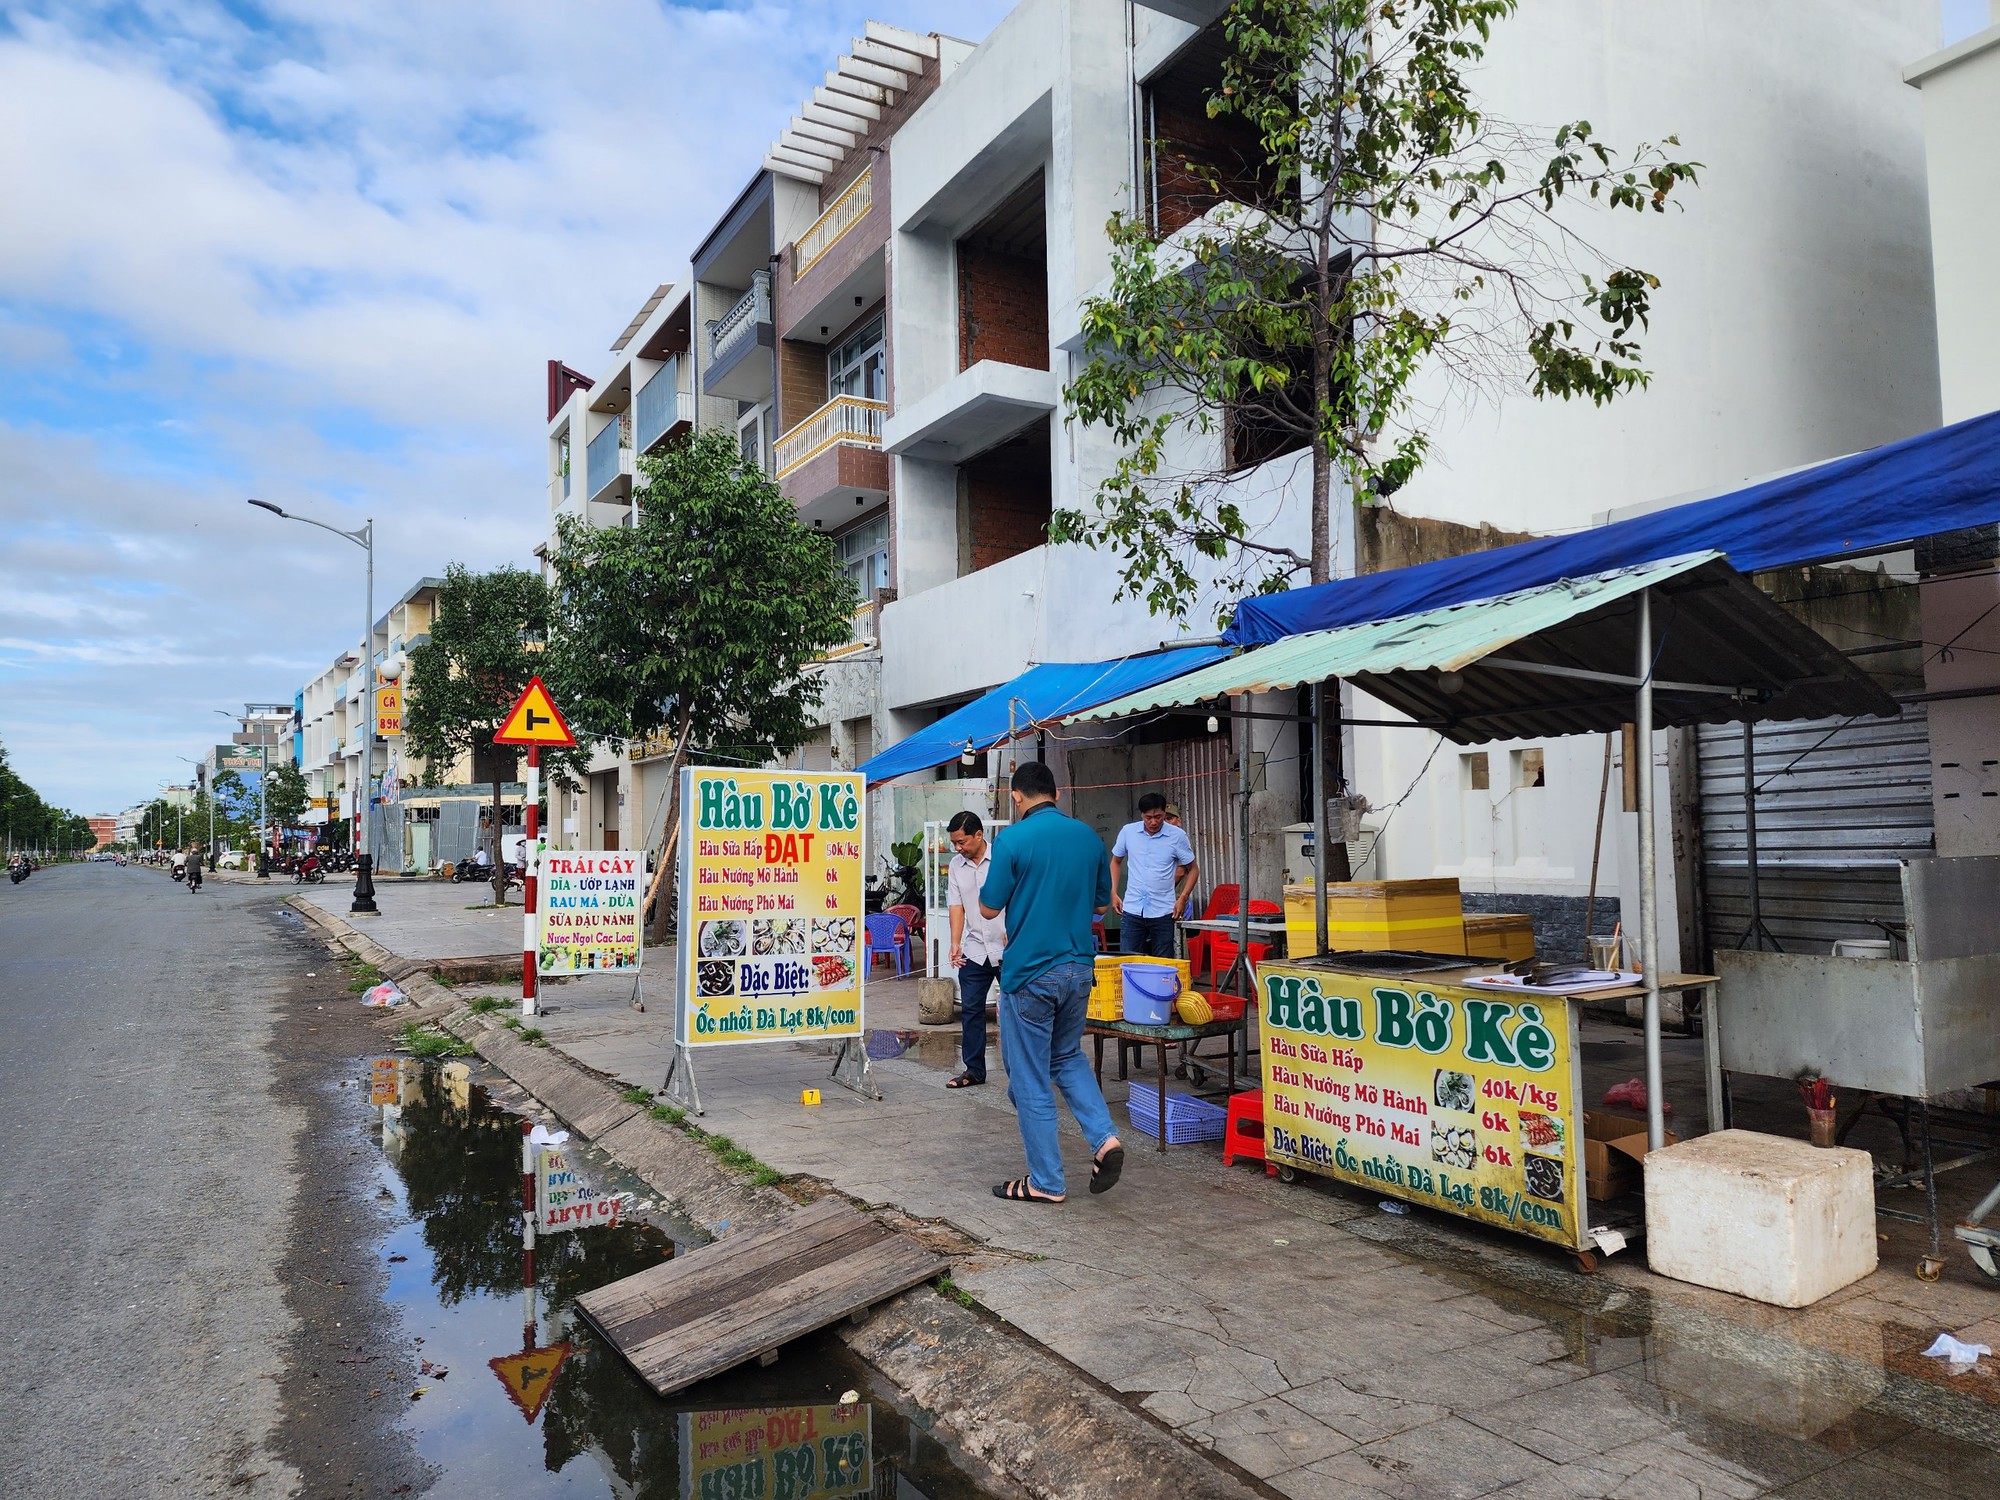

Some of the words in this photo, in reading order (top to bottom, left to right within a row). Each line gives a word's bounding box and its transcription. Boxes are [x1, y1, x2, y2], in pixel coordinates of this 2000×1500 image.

[380, 718, 399, 730] 89K
[699, 780, 762, 829] Hàu
[771, 781, 811, 829] Bờ
[818, 781, 859, 830] Kè
[699, 840, 719, 856] Hàu
[722, 840, 740, 856] Sữa
[744, 838, 762, 859] Hấp
[765, 833, 814, 867] ĐẠT
[549, 856, 594, 874] TRÁI
[598, 856, 636, 874] CÂY
[826, 868, 838, 882] 6k
[550, 877, 570, 890] DĨA
[580, 877, 602, 890] ƯỚP
[604, 880, 634, 892] LẠNH
[699, 868, 718, 884] Hàu
[722, 868, 754, 887] Nướng
[774, 868, 798, 883] Hành
[550, 896, 578, 908] RAU
[580, 894, 598, 908] MÁ
[608, 894, 634, 908] DỪA
[698, 896, 718, 911] Hàu
[722, 895, 754, 914] Nướng
[756, 894, 774, 910] Phô
[826, 894, 838, 908] 6k
[549, 912, 572, 926] SỮA
[575, 912, 600, 928] ĐẬU
[602, 912, 634, 926] NÀNH
[740, 963, 770, 998] Đặc
[774, 961, 809, 996] Biệt:
[696, 1003, 716, 1034] Ốc
[720, 1006, 752, 1032] nhồi
[756, 1008, 776, 1029] Đà
[780, 1008, 803, 1034] Lạt
[806, 1006, 854, 1030] 8k/con
[1266, 976, 1360, 1038] Hàu
[1374, 990, 1452, 1052] Bờ
[1465, 1000, 1553, 1068] Kè
[1270, 1038, 1297, 1058] Hàu
[1300, 1043, 1328, 1064] Sữa
[1332, 1048, 1364, 1072] Hấp
[808, 1091, 814, 1101] 7
[1272, 1066, 1300, 1086] Hàu
[1302, 1072, 1350, 1102] Nướng
[1354, 1082, 1378, 1104] Mỡ
[1382, 1088, 1428, 1116] Hành
[1482, 1078, 1558, 1112] 40k/kg
[1273, 1094, 1300, 1116] Hàu
[1304, 1101, 1351, 1133] Nướng
[1356, 1114, 1386, 1137] Phô
[1390, 1122, 1420, 1146] Mai
[1482, 1111, 1511, 1132] 6k
[1484, 1144, 1514, 1167] 6k
[1272, 1126, 1298, 1159] Đặc
[1300, 1134, 1333, 1168] Biệt:
[1334, 1138, 1358, 1172] Ốc
[1362, 1155, 1404, 1186] nhồi
[1406, 1165, 1436, 1195] Đà
[1439, 1174, 1475, 1209] Lạt
[1479, 1186, 1562, 1229] 8k/con
